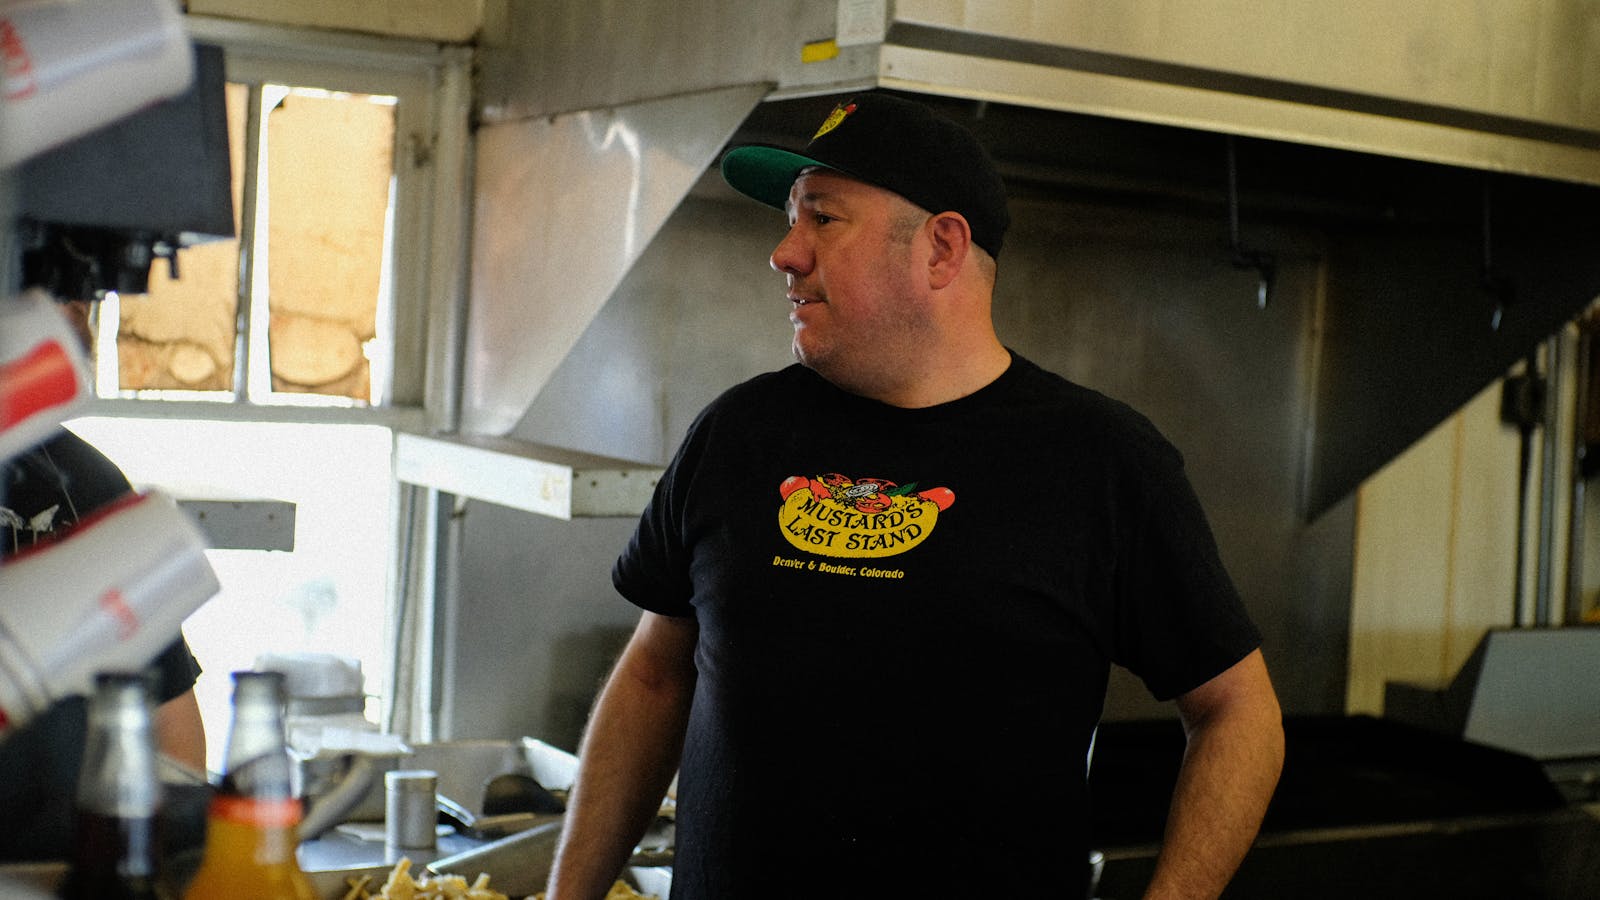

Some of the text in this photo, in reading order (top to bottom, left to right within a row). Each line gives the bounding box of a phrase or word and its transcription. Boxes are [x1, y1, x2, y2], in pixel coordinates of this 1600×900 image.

[797, 498, 923, 530] MUSTARD'S
[785, 515, 922, 550] LAST STAND
[773, 555, 905, 579] Denver & Boulder, Colorado
